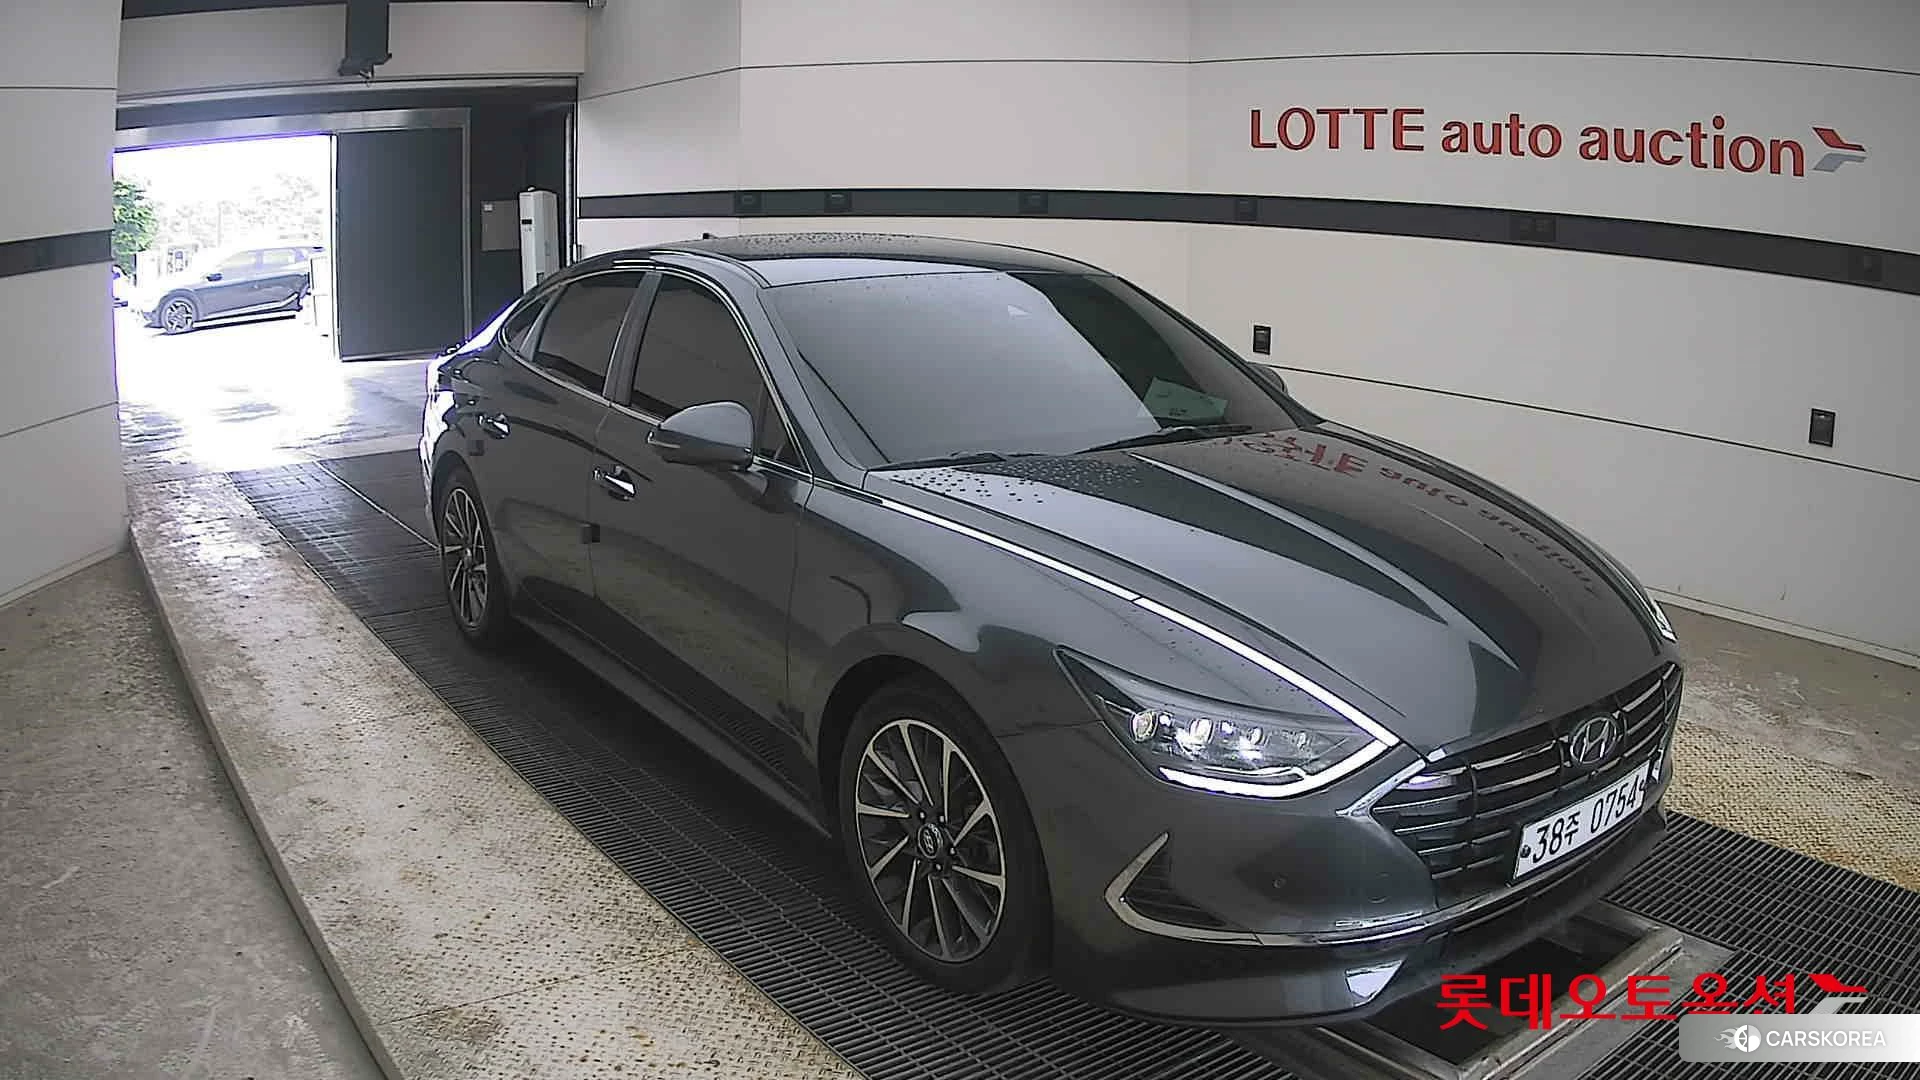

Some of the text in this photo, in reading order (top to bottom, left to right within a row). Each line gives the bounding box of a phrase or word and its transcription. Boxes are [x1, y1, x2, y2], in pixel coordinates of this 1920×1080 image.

[1250, 107, 1806, 177] LOTTE auto auction
[1532, 774, 1640, 864] 38주 0754
